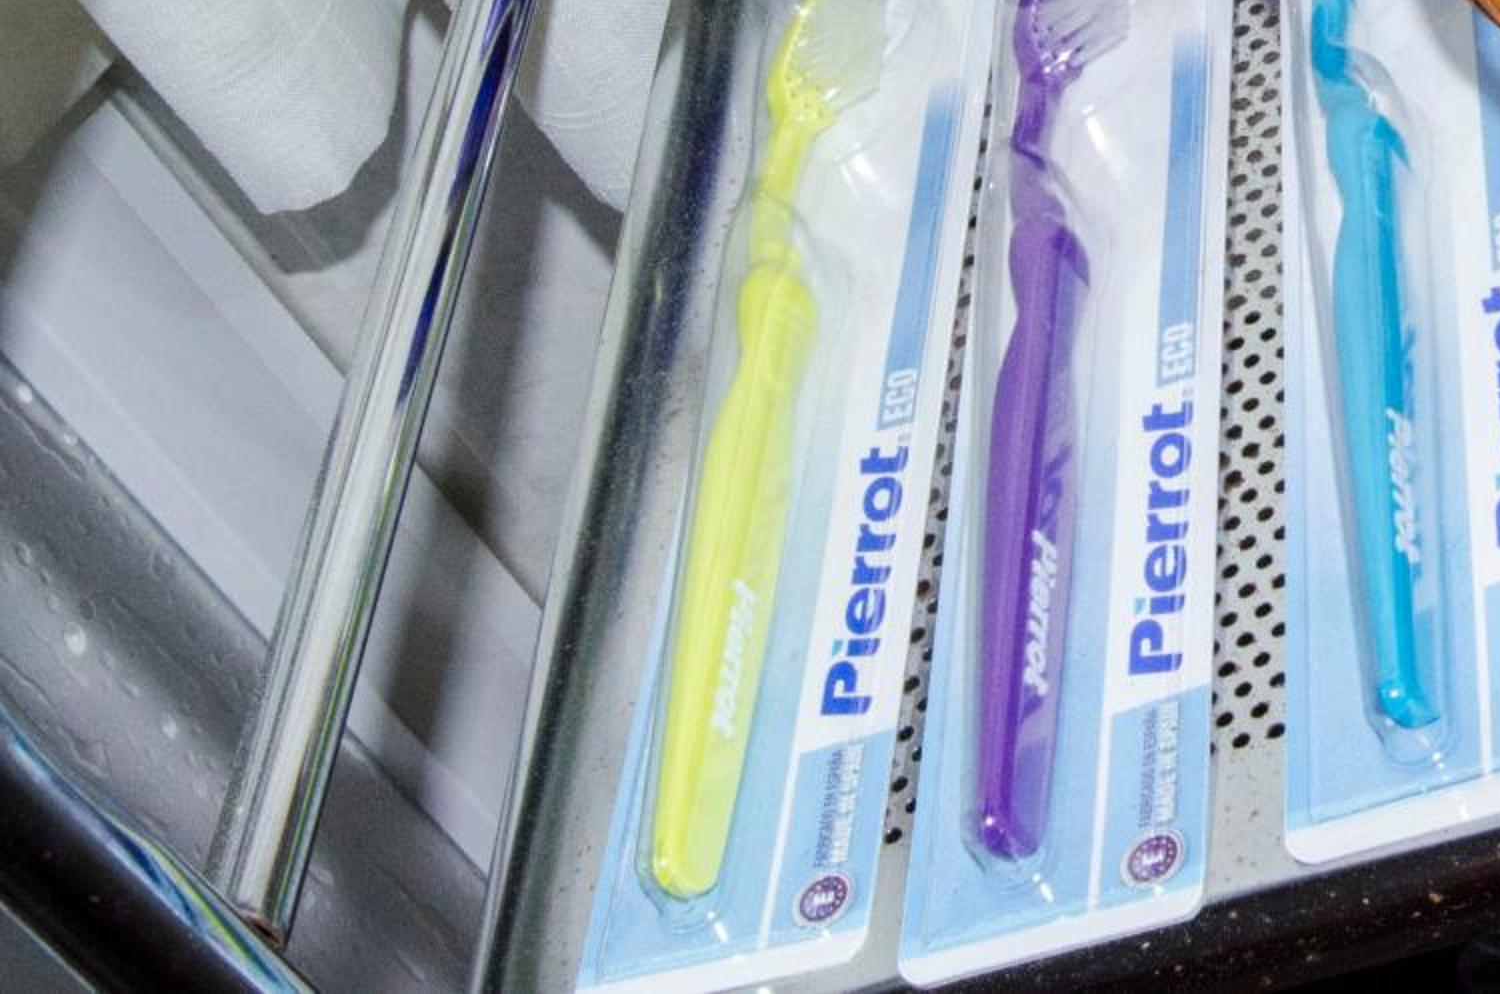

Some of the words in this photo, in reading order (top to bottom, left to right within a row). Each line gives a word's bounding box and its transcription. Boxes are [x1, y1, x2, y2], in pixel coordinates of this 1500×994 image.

[821, 445, 909, 717] Pierrot
[882, 368, 918, 422] ECO
[1021, 531, 1058, 696] Pierrot
[1128, 401, 1194, 676] Pierrot
[1161, 323, 1194, 379] ECO
